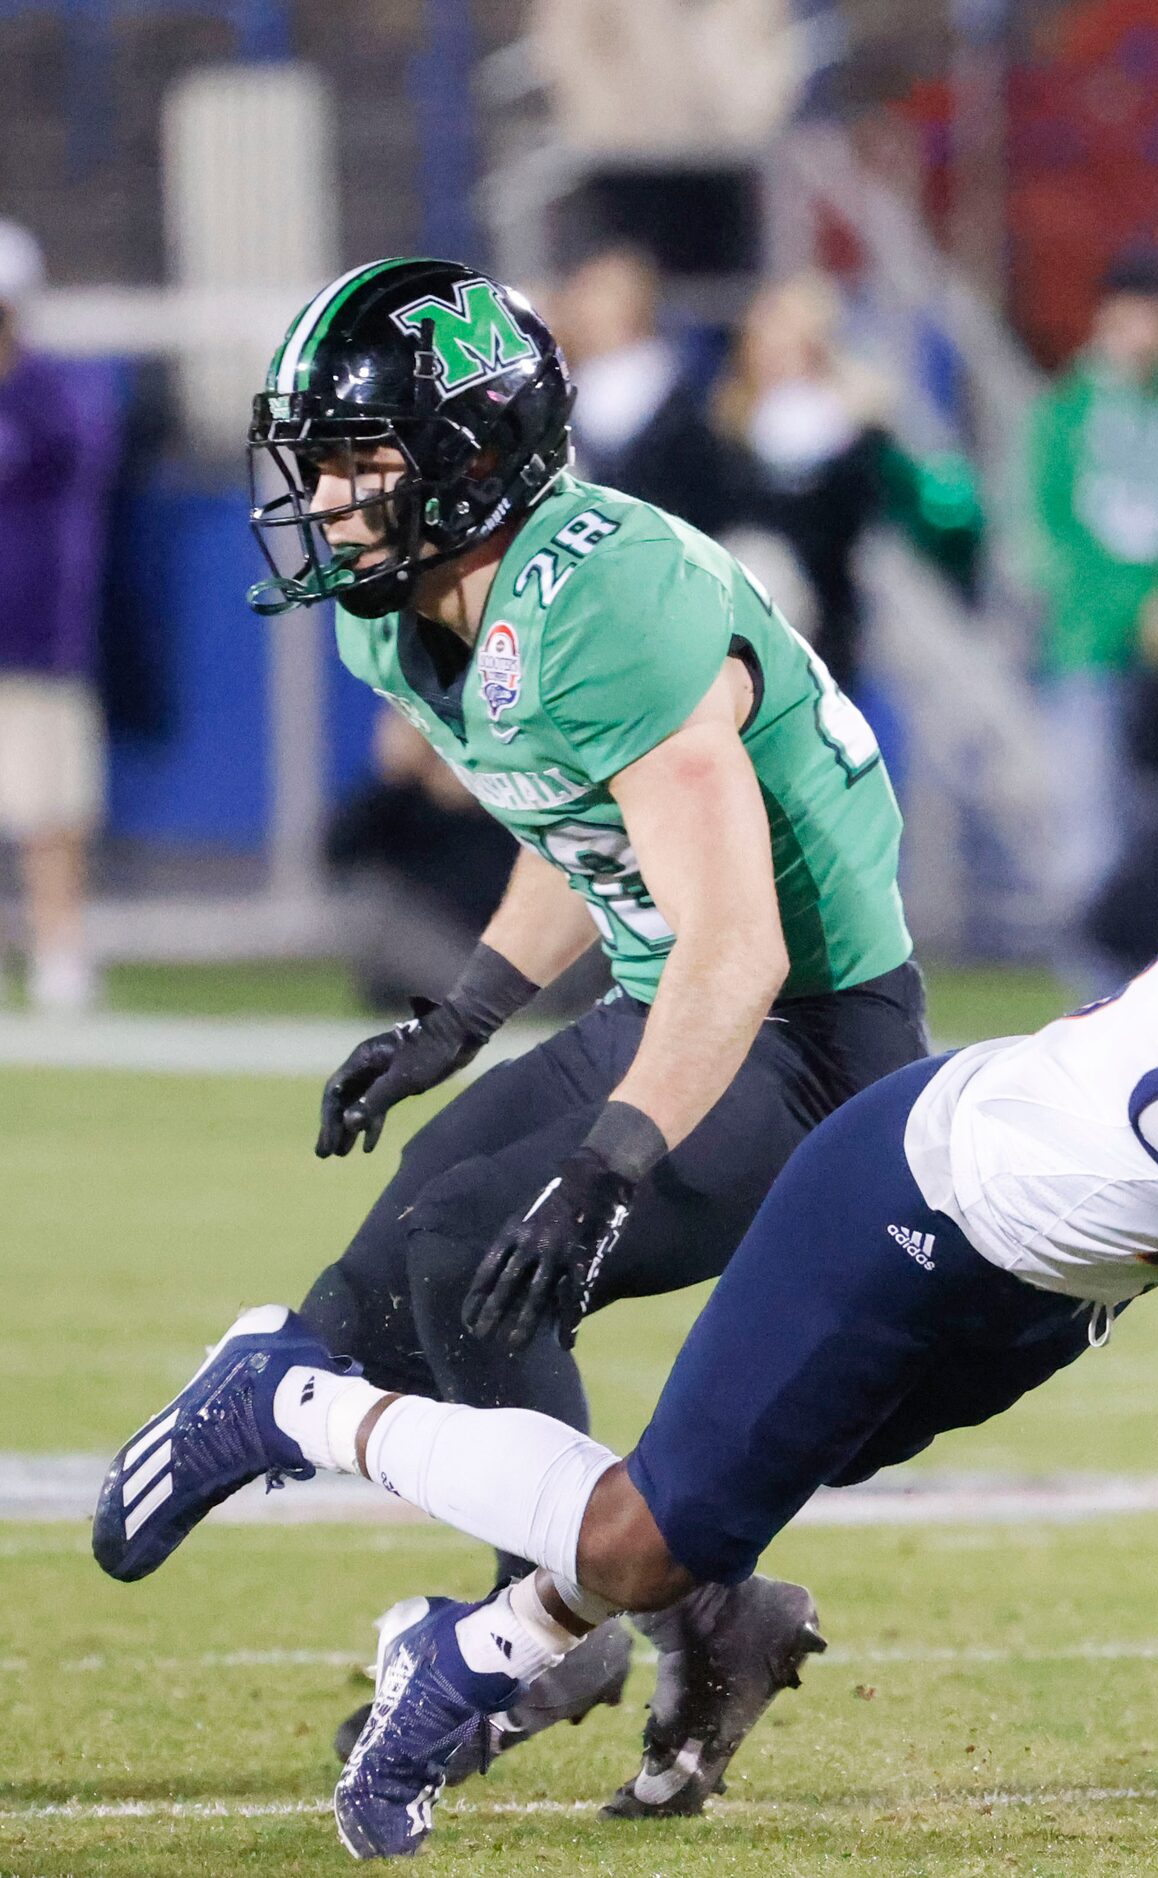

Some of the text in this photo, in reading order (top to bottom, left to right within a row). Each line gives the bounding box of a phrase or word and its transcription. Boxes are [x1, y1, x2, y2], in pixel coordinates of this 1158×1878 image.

[389, 277, 541, 398] M
[512, 508, 622, 610] 28
[887, 1224, 935, 1271] adidas
